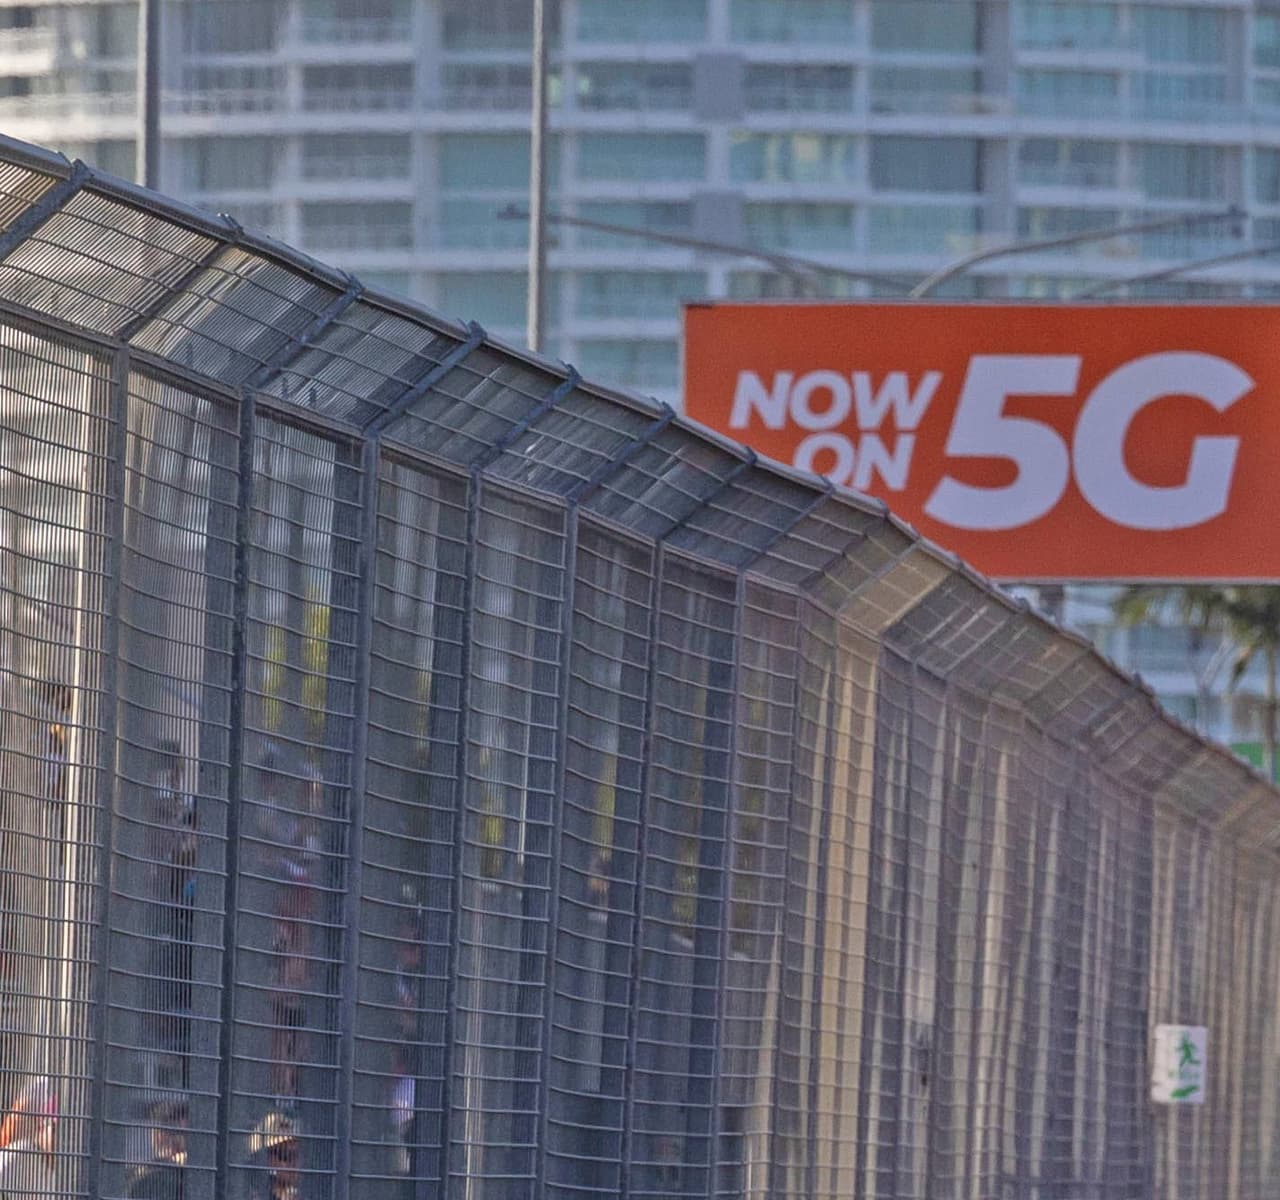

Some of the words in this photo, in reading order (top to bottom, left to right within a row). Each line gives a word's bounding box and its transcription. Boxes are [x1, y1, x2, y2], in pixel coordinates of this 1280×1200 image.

[729, 370, 942, 430] NOW
[793, 431, 917, 492] ON
[923, 350, 1256, 532] 5G
